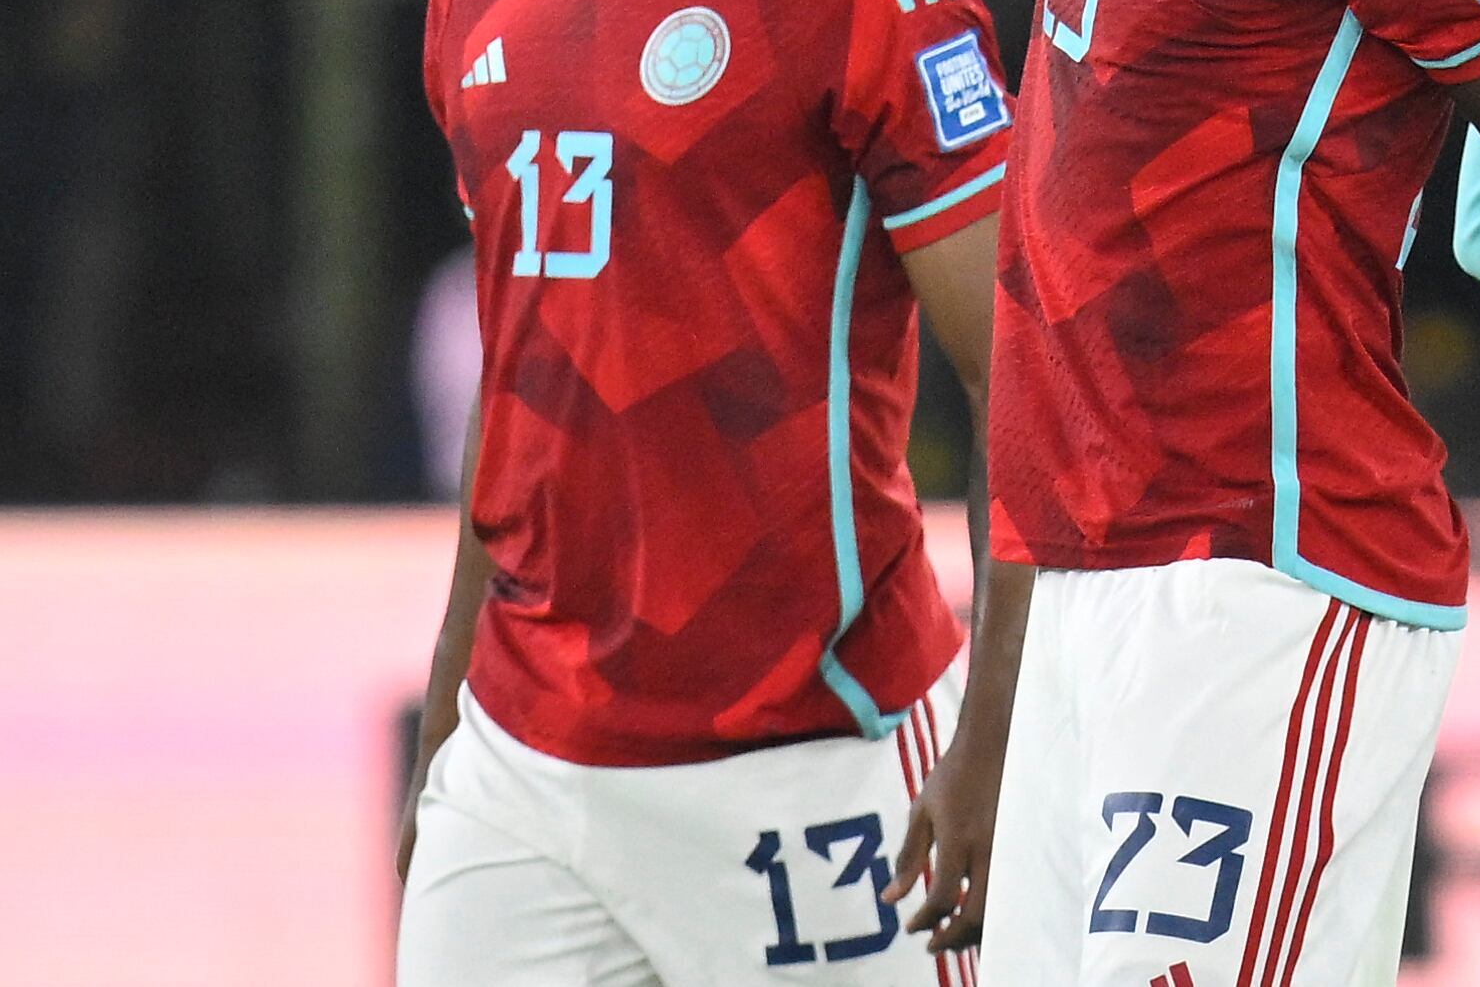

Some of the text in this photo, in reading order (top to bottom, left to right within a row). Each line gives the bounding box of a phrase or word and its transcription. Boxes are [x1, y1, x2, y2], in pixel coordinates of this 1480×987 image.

[505, 129, 613, 279] 13
[744, 812, 900, 967] 13
[1088, 791, 1254, 944] 23
